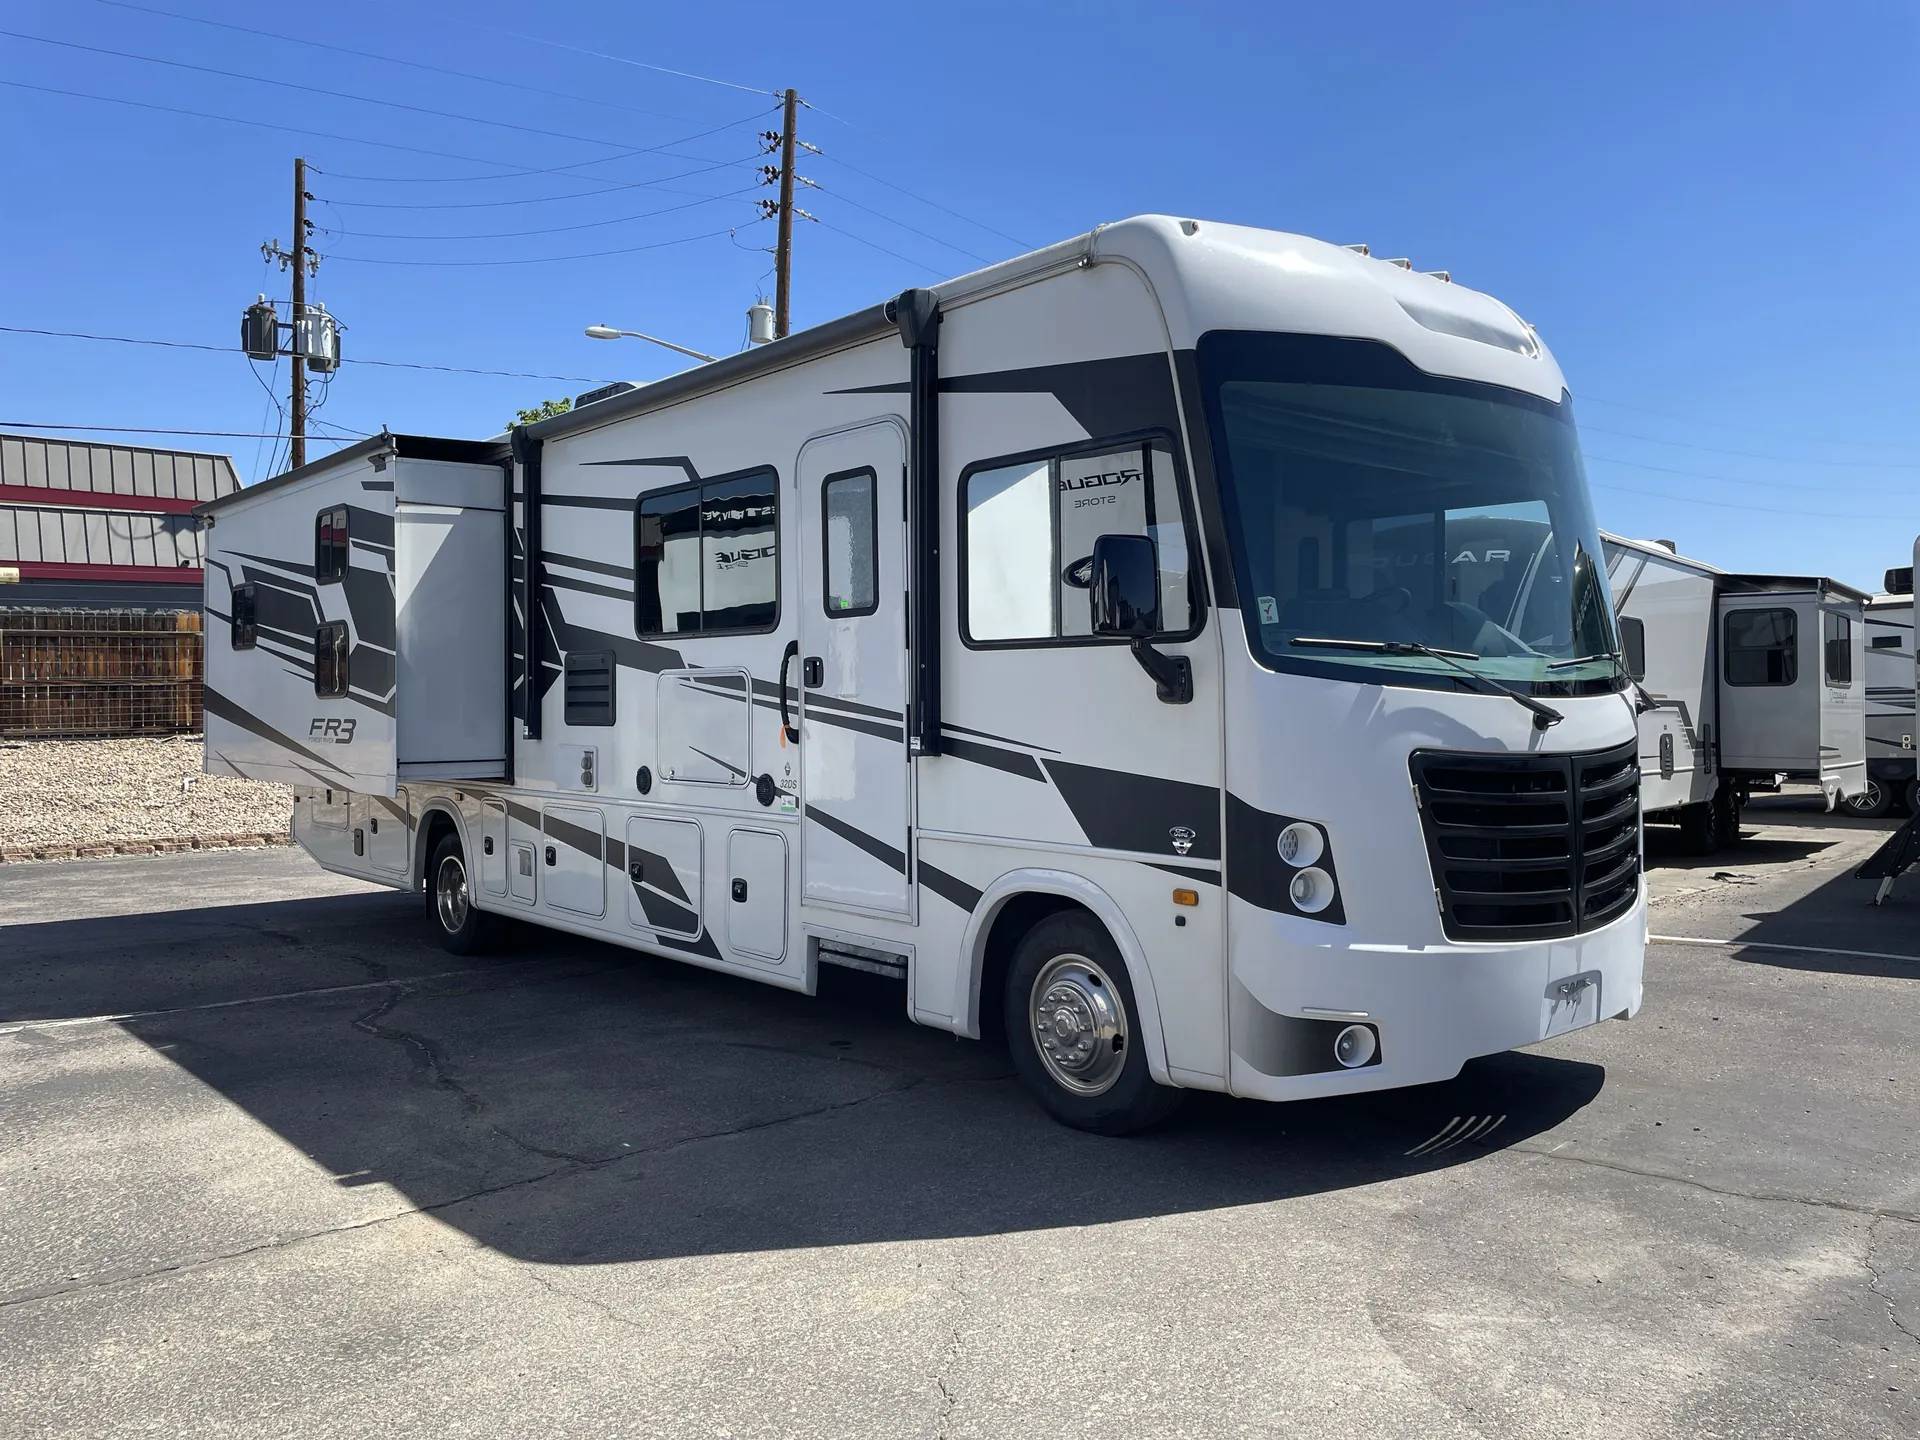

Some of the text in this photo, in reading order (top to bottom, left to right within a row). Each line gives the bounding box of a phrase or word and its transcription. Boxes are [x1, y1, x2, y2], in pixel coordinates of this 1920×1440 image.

[309, 718, 357, 744] FR3
[780, 779, 797, 789] 32DS
[1173, 828, 1189, 838] Ford
